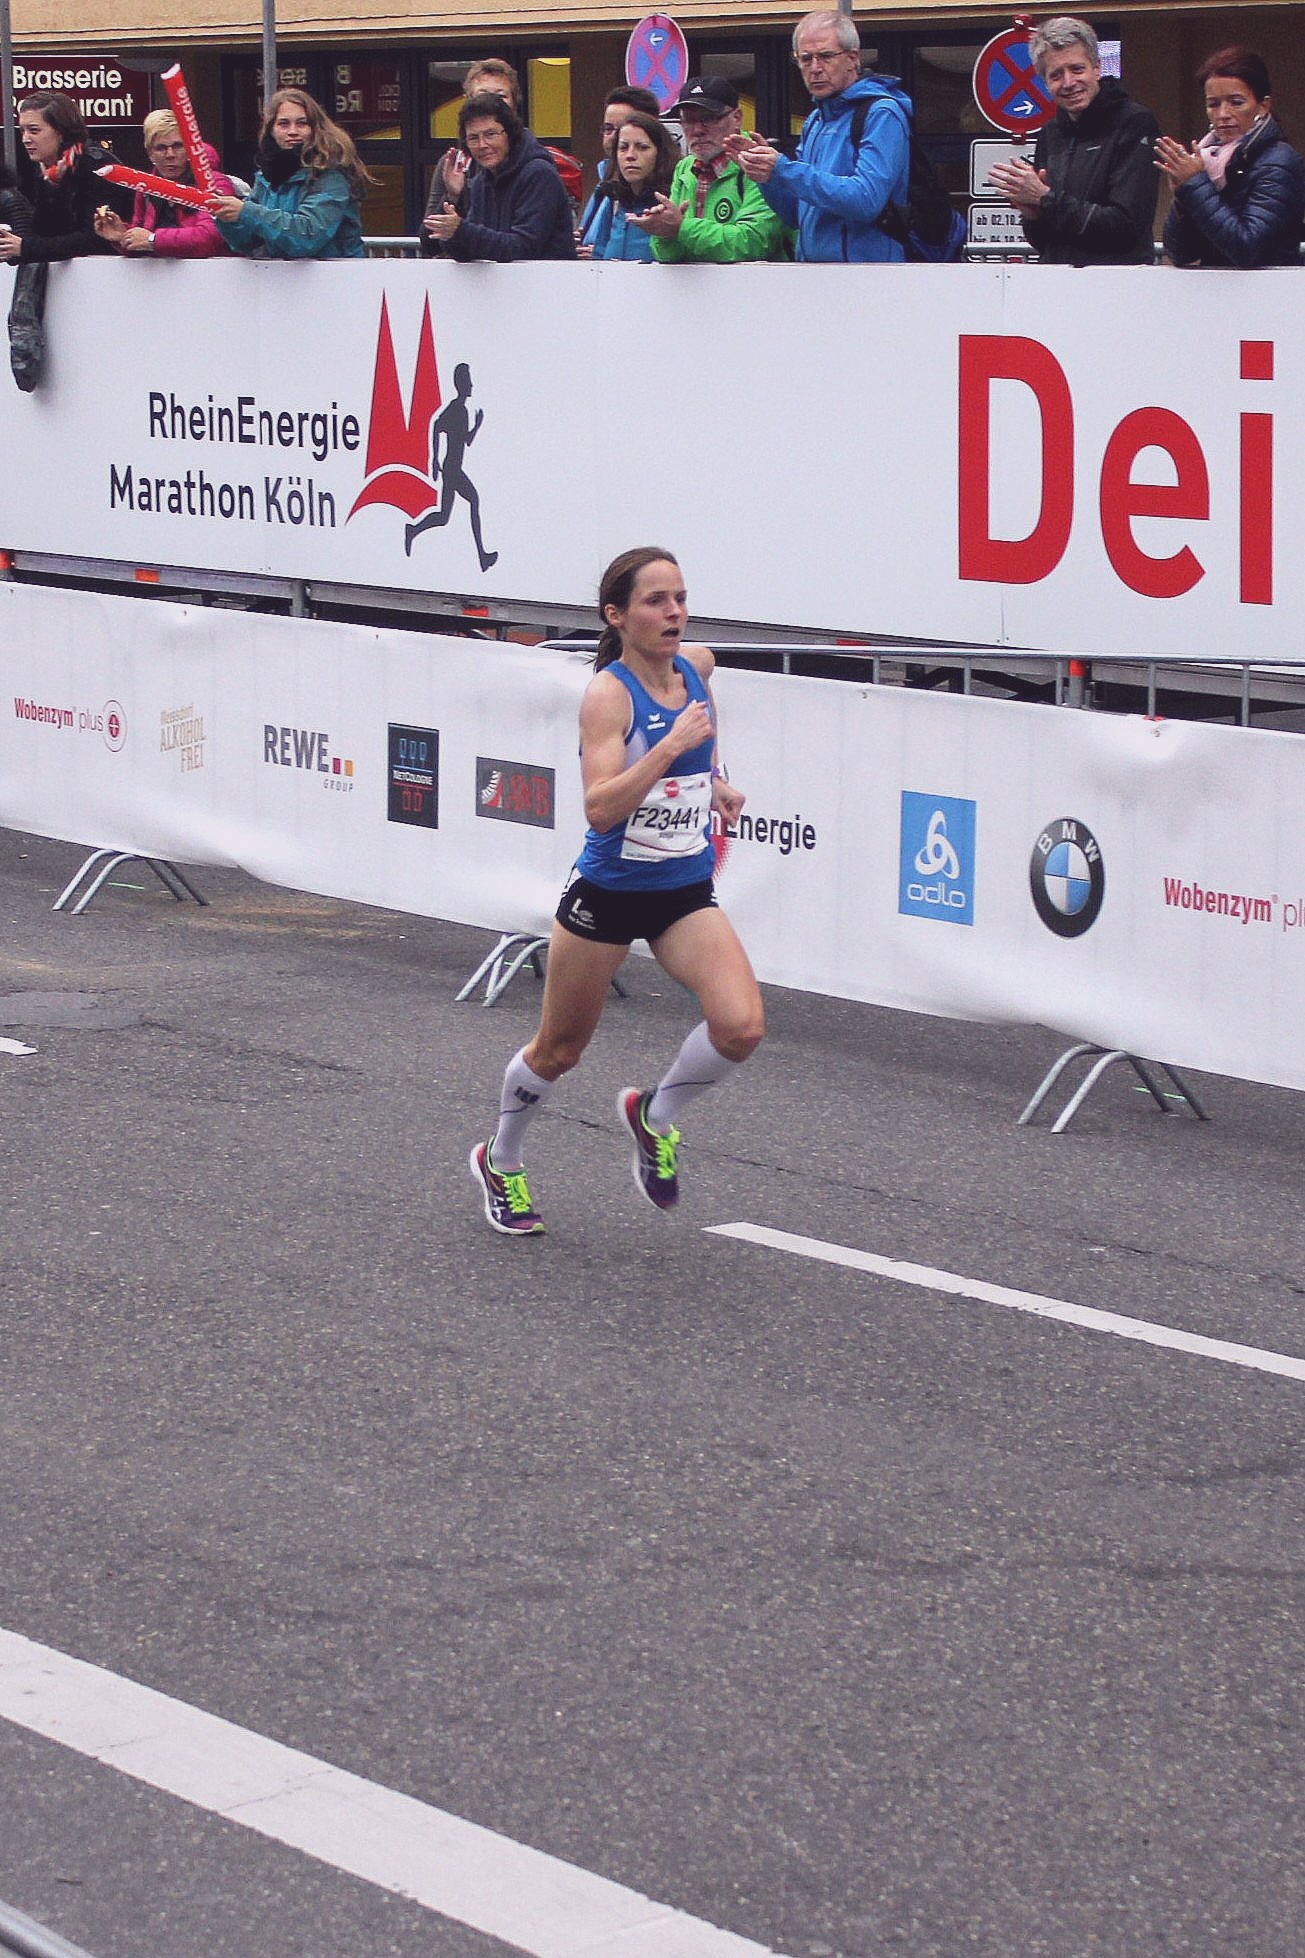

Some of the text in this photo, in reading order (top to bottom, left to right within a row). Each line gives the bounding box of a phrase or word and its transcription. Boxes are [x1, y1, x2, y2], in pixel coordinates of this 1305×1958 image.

[12, 65, 122, 89] Brasserie
[149, 391, 361, 462] RheinEnergie
[958, 334, 1274, 605] Dei
[110, 463, 337, 528] Marathon Köln
[79, 707, 104, 733] plus
[159, 716, 207, 752] ALKOHOL
[181, 743, 204, 773] FREI
[263, 724, 330, 773] REWE
[322, 778, 354, 793] GROUP
[631, 806, 700, 830] F23441
[1037, 820, 1101, 863] BMW
[907, 882, 966, 908] odlo
[1283, 898, 1305, 933] pl
